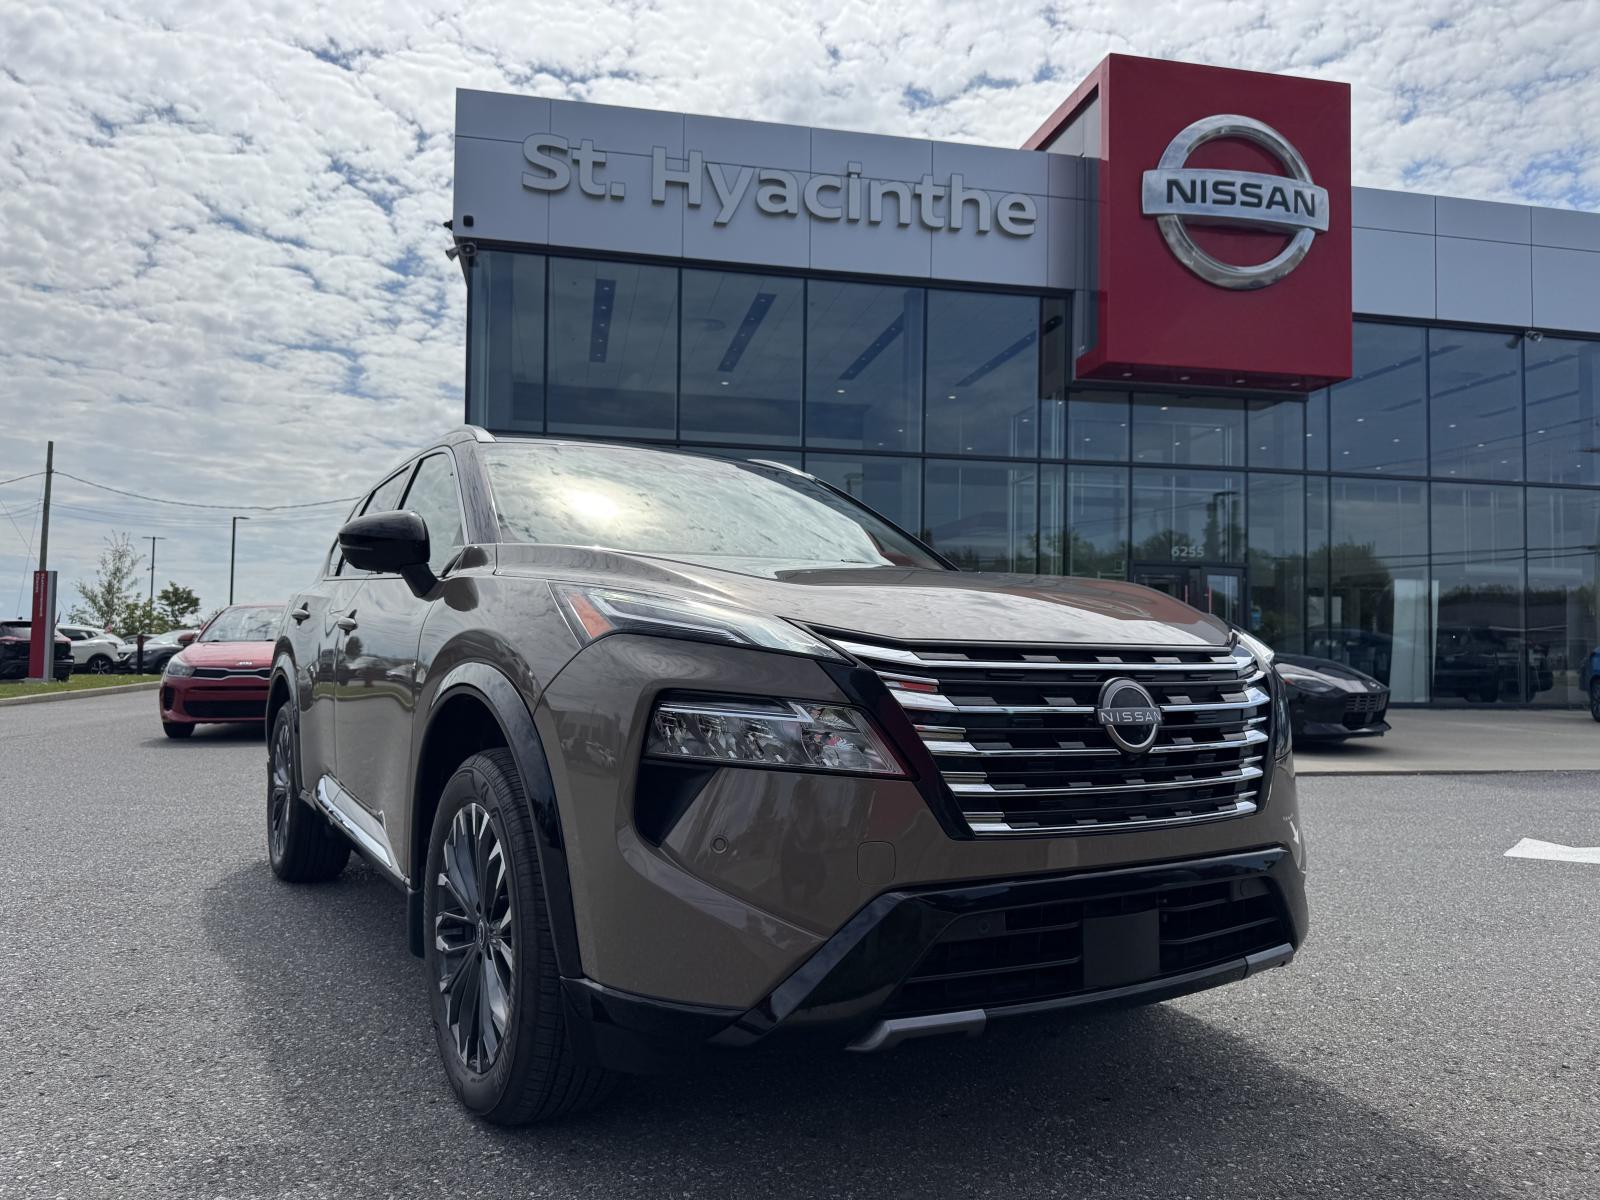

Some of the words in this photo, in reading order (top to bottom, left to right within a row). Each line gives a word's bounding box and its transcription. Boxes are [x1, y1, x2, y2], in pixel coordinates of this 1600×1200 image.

[522, 132, 626, 200] St.
[652, 145, 1037, 237] Hyacinthe
[1166, 179, 1316, 218] NISSAN
[1171, 545, 1205, 558] 6255
[1101, 711, 1161, 722] NISSAN
